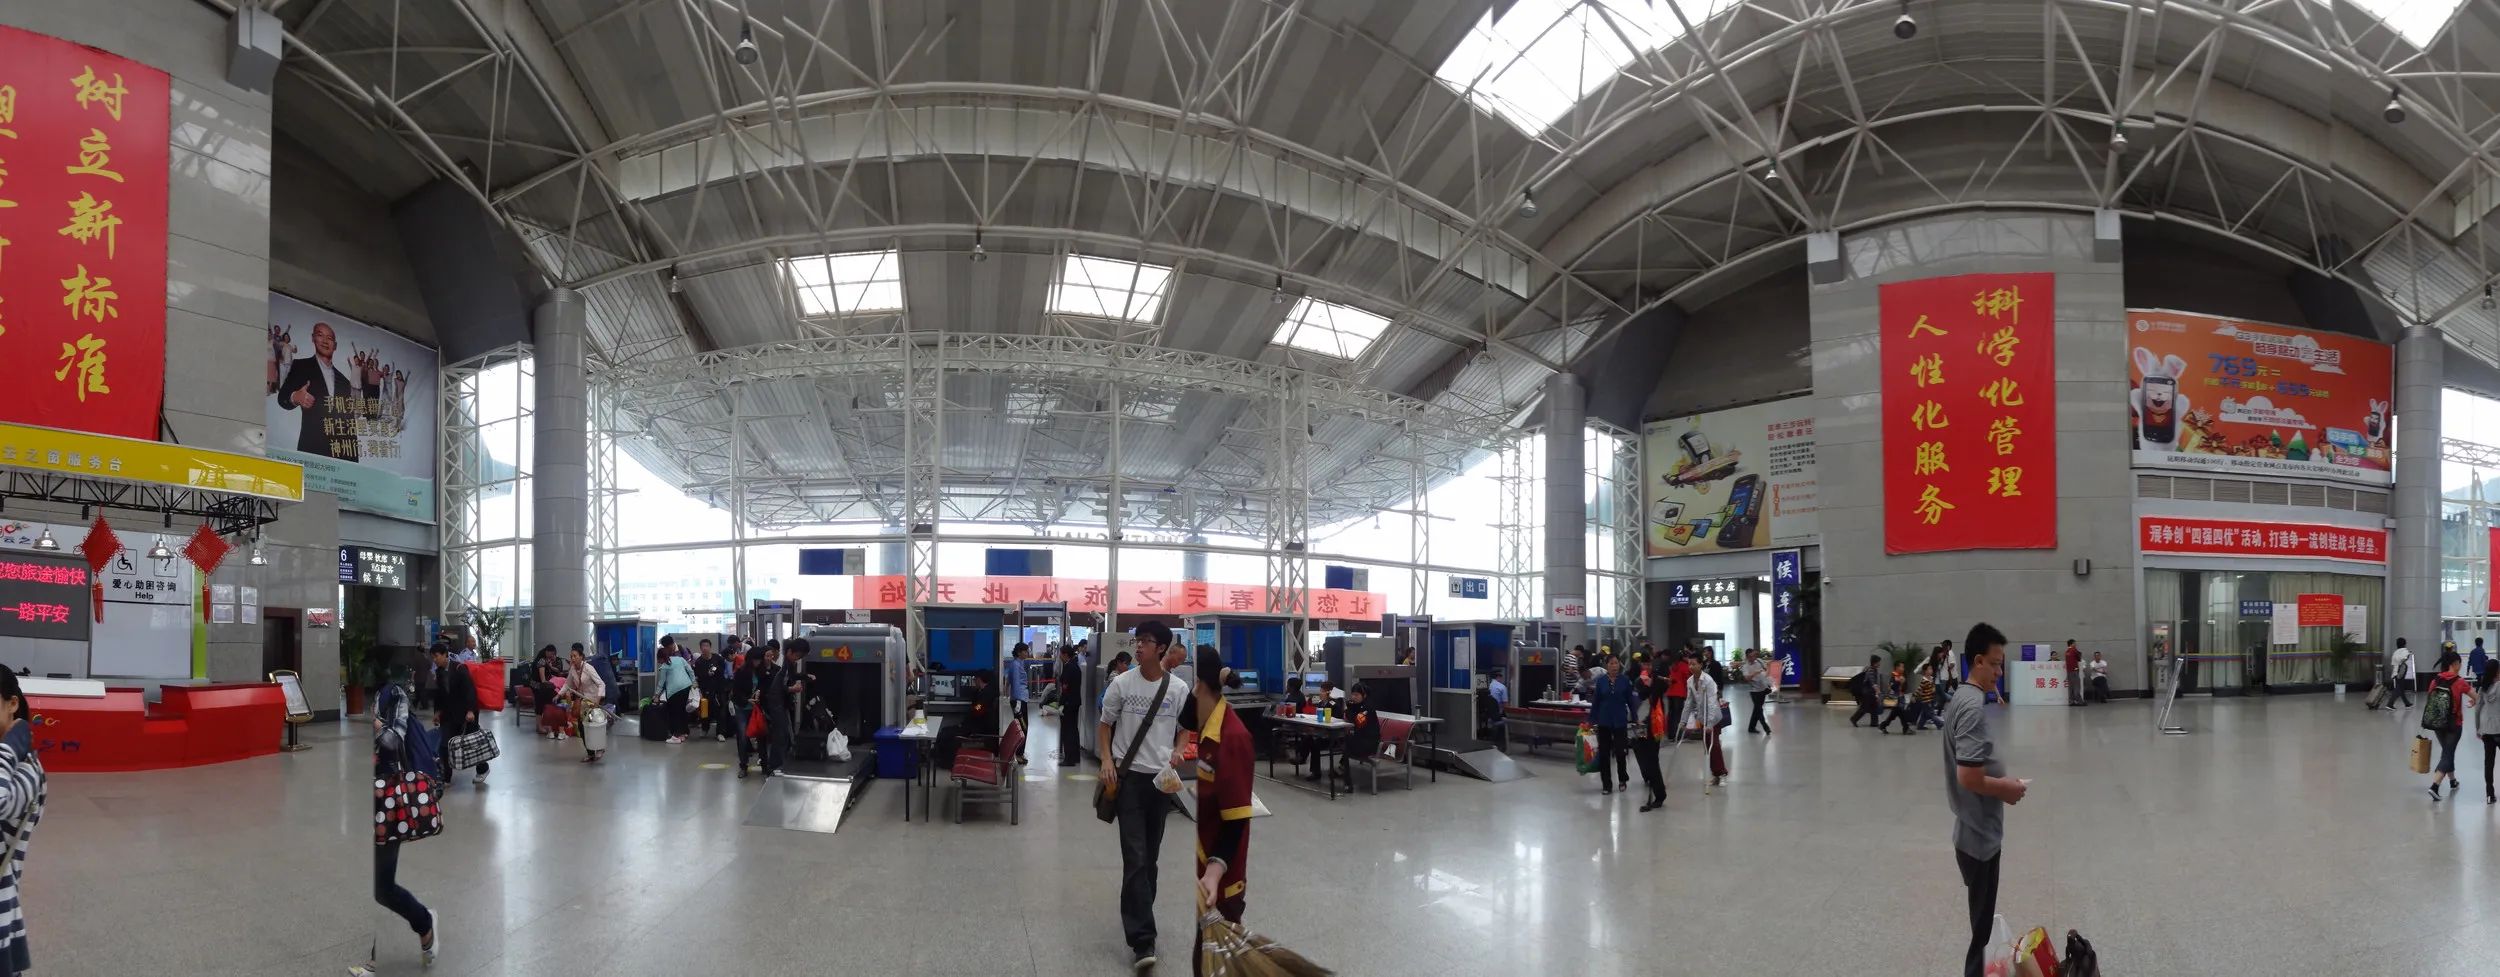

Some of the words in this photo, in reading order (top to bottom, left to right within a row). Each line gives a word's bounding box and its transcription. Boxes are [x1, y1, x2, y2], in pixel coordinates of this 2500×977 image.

[55, 65, 129, 402] 树立新标准
[1972, 285, 2025, 497] 科学化管理
[1908, 315, 1956, 525] 人性化服务
[3, 445, 123, 472] 云之窗服务台
[341, 549, 347, 561] 6
[112, 578, 177, 592] 爱心助困咨询
[1466, 580, 1486, 592] 出口
[1676, 585, 1683, 597] 2
[135, 591, 155, 600] Help
[2, 602, 70, 624] 一路平安
[1565, 604, 1585, 616] 出口
[838, 644, 849, 660] 4
